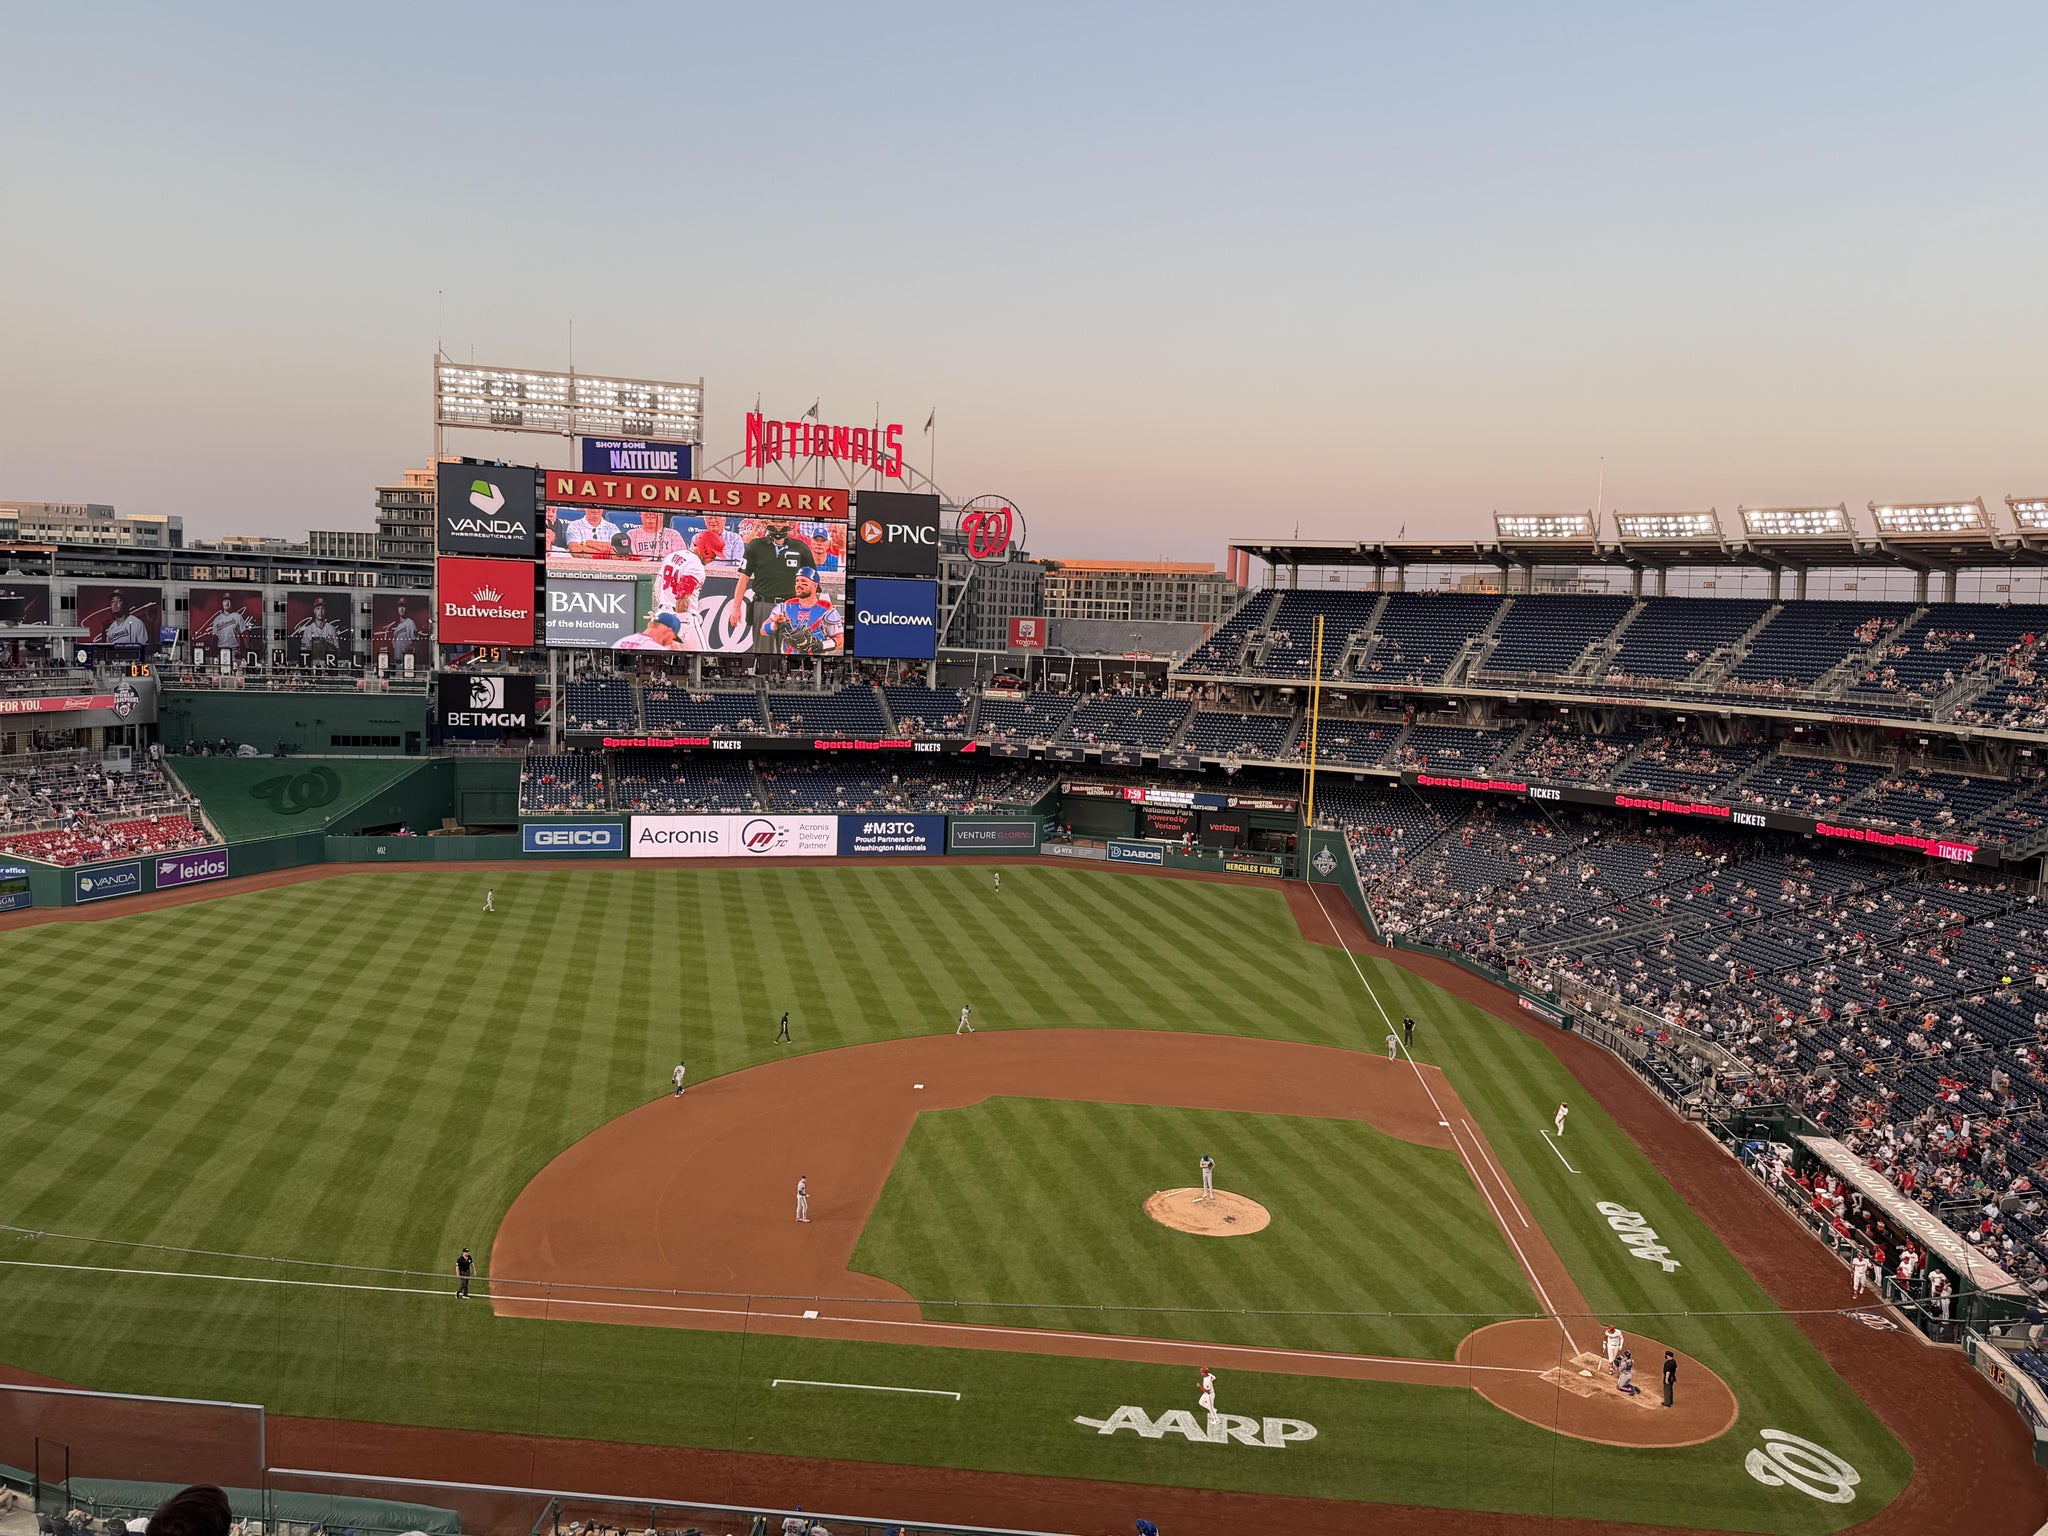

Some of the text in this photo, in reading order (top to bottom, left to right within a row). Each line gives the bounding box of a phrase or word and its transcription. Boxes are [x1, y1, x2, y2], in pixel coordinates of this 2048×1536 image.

[595, 441, 620, 449] SHOW
[745, 412, 903, 477] NATIONALS
[610, 450, 678, 471] NATITUDE
[557, 478, 834, 511] NATIONALS PARK
[447, 517, 527, 535] VANDA
[886, 523, 936, 545] PNC
[547, 570, 637, 581] losnacionales.com
[548, 591, 627, 615] BANK
[444, 602, 528, 619] Budweiser
[546, 619, 620, 629] of the Nationals
[857, 610, 933, 627] Qualcomm
[0, 700, 43, 713] FOR YOU.
[447, 712, 526, 727] BETMGM
[603, 736, 742, 750] Sports Illustrated TICKETS
[814, 739, 941, 752] Sports Illustrated TICKETS
[1417, 774, 1561, 800] Sports Illustrated TICKETS
[1127, 789, 1142, 799] 7:59
[1143, 806, 1194, 817] Nationals Park
[1615, 794, 1766, 827] Sports Illustrated TICKETS
[1147, 814, 1188, 824] powered by
[799, 824, 829, 832] Acronis
[863, 822, 915, 835] #M3TC
[1154, 822, 1181, 830] Verizon
[1209, 823, 1240, 833] verizon
[534, 830, 611, 845] GEICO
[639, 827, 719, 844] Acronis
[799, 832, 830, 842] Delivery
[957, 831, 996, 840] VENTURE
[799, 841, 828, 850] Partner
[853, 844, 927, 853] Washington Nationals
[1816, 822, 1973, 863] Sports Illustrated TICKETS
[376, 846, 386, 855] 402
[1122, 849, 1161, 860] DABOS
[179, 860, 225, 880] leidos
[1225, 862, 1281, 875] HERCULES FENCE
[93, 872, 136, 887] VANDA
[1829, 1153, 1984, 1268] WASHINGTON NATIONALS
[1596, 1201, 1681, 1273] AARP
[1073, 1405, 1318, 1448] AARP
[787, 1525, 798, 1534] 65
